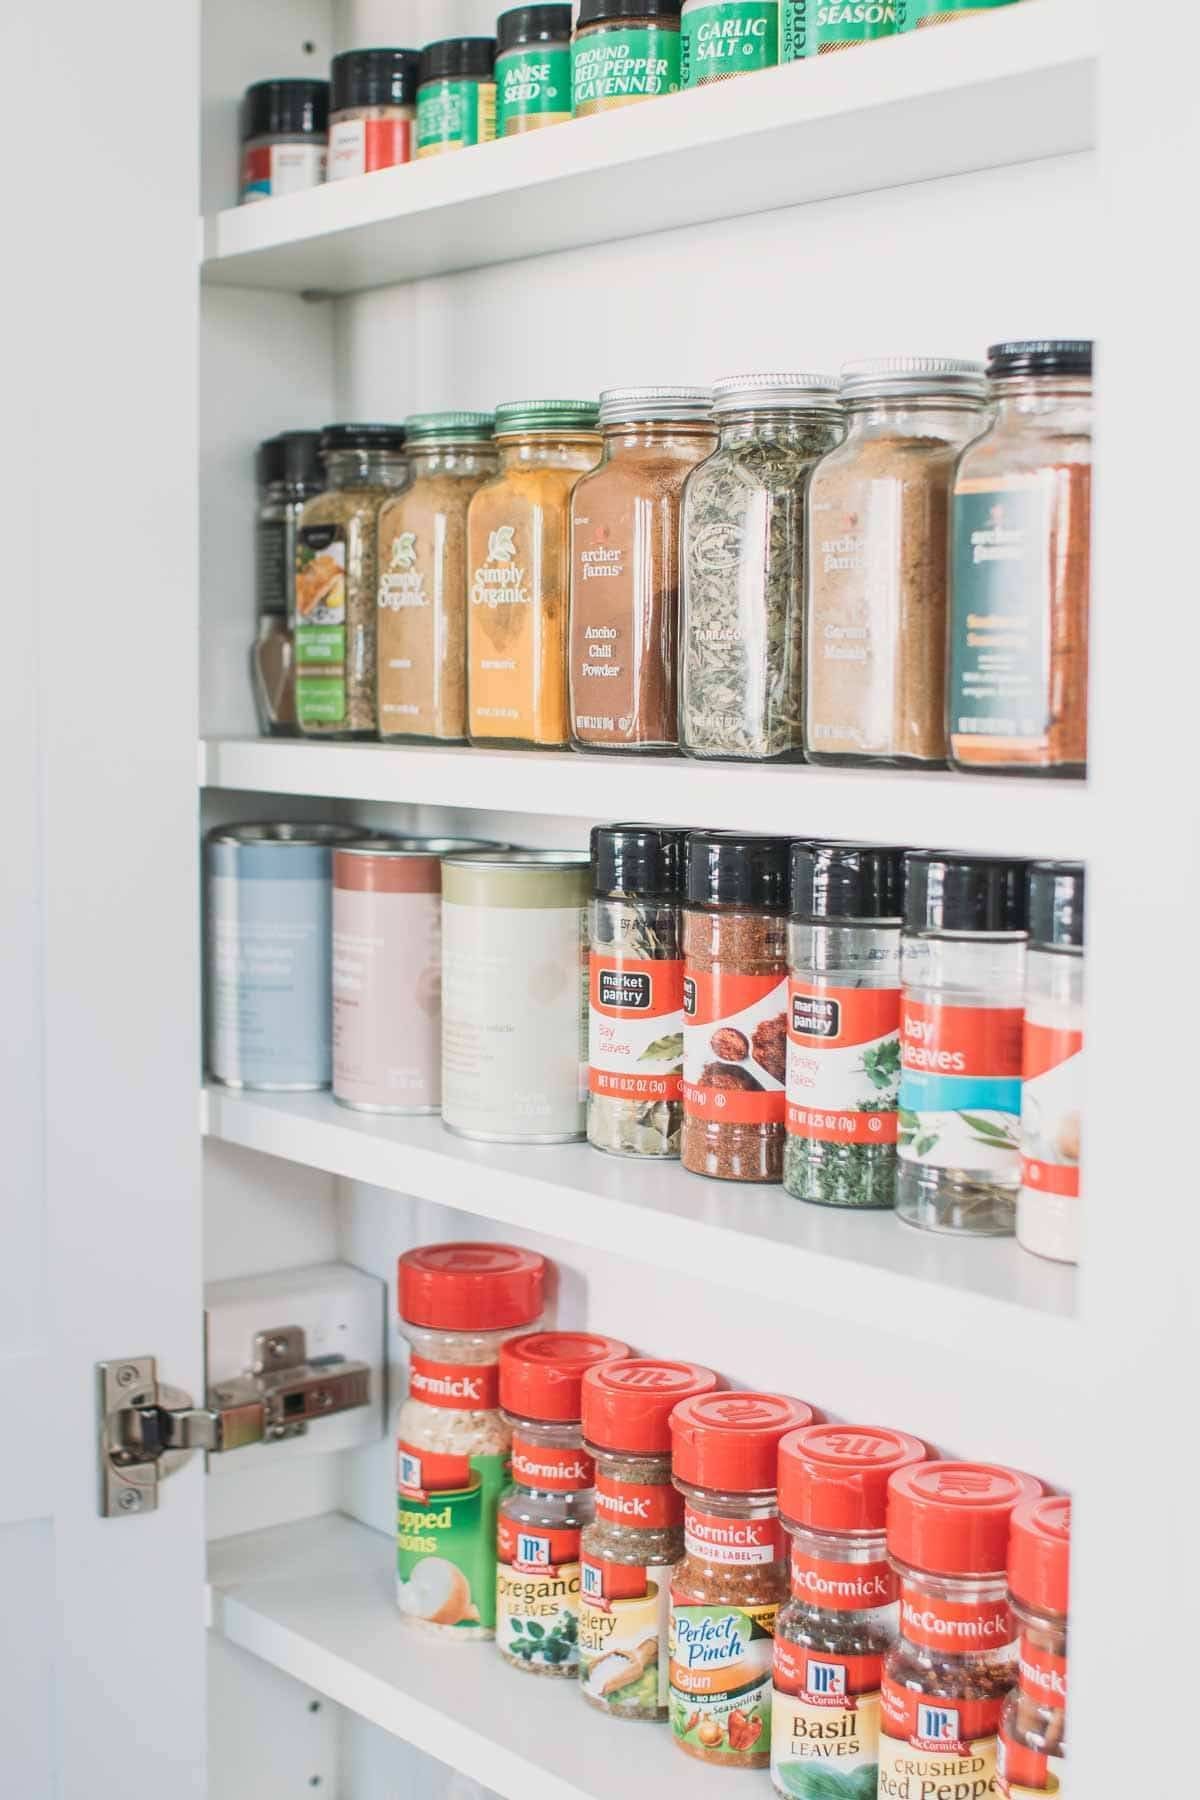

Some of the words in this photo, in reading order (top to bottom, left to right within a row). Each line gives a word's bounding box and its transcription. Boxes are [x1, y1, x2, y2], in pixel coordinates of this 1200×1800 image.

[697, 19, 767, 42] GARLIC
[787, 0, 806, 60] rend
[575, 44, 630, 68] GROUND
[696, 38, 738, 61] SALT
[504, 63, 551, 86] ANISE
[575, 63, 600, 84] RED
[602, 59, 669, 78] PEPPER
[504, 83, 540, 105] SEED
[575, 75, 663, 103] (CAYENNE)
[581, 546, 622, 562] archer
[584, 625, 617, 639] Ancho
[695, 630, 742, 641] TARRAGO
[588, 644, 612, 658] Chili
[582, 663, 621, 677] Powder
[603, 976, 643, 988] market
[603, 989, 643, 1005] pantry
[794, 1000, 833, 1015] market
[794, 1016, 832, 1033] pantry
[904, 1014, 934, 1043] bay
[904, 1042, 966, 1070] leaves
[609, 1077, 619, 1090] WT
[637, 1080, 646, 1091] OZ
[649, 1080, 667, 1094] (3g)
[723, 1552, 751, 1560] LABEL
[791, 1560, 888, 1597] McCormick
[677, 1614, 735, 1643] Perfect
[902, 1601, 1008, 1638] McCormick
[688, 1631, 742, 1668] Pinch
[676, 1668, 711, 1690] Cajun
[712, 1691, 762, 1714] Seasoning
[801, 1692, 851, 1706] McCormick
[792, 1713, 857, 1739] Basil
[791, 1740, 860, 1758] LEAVES
[910, 1735, 965, 1751] McCormick
[894, 1758, 985, 1777] CRUSHED
[880, 1770, 910, 1800] Red
